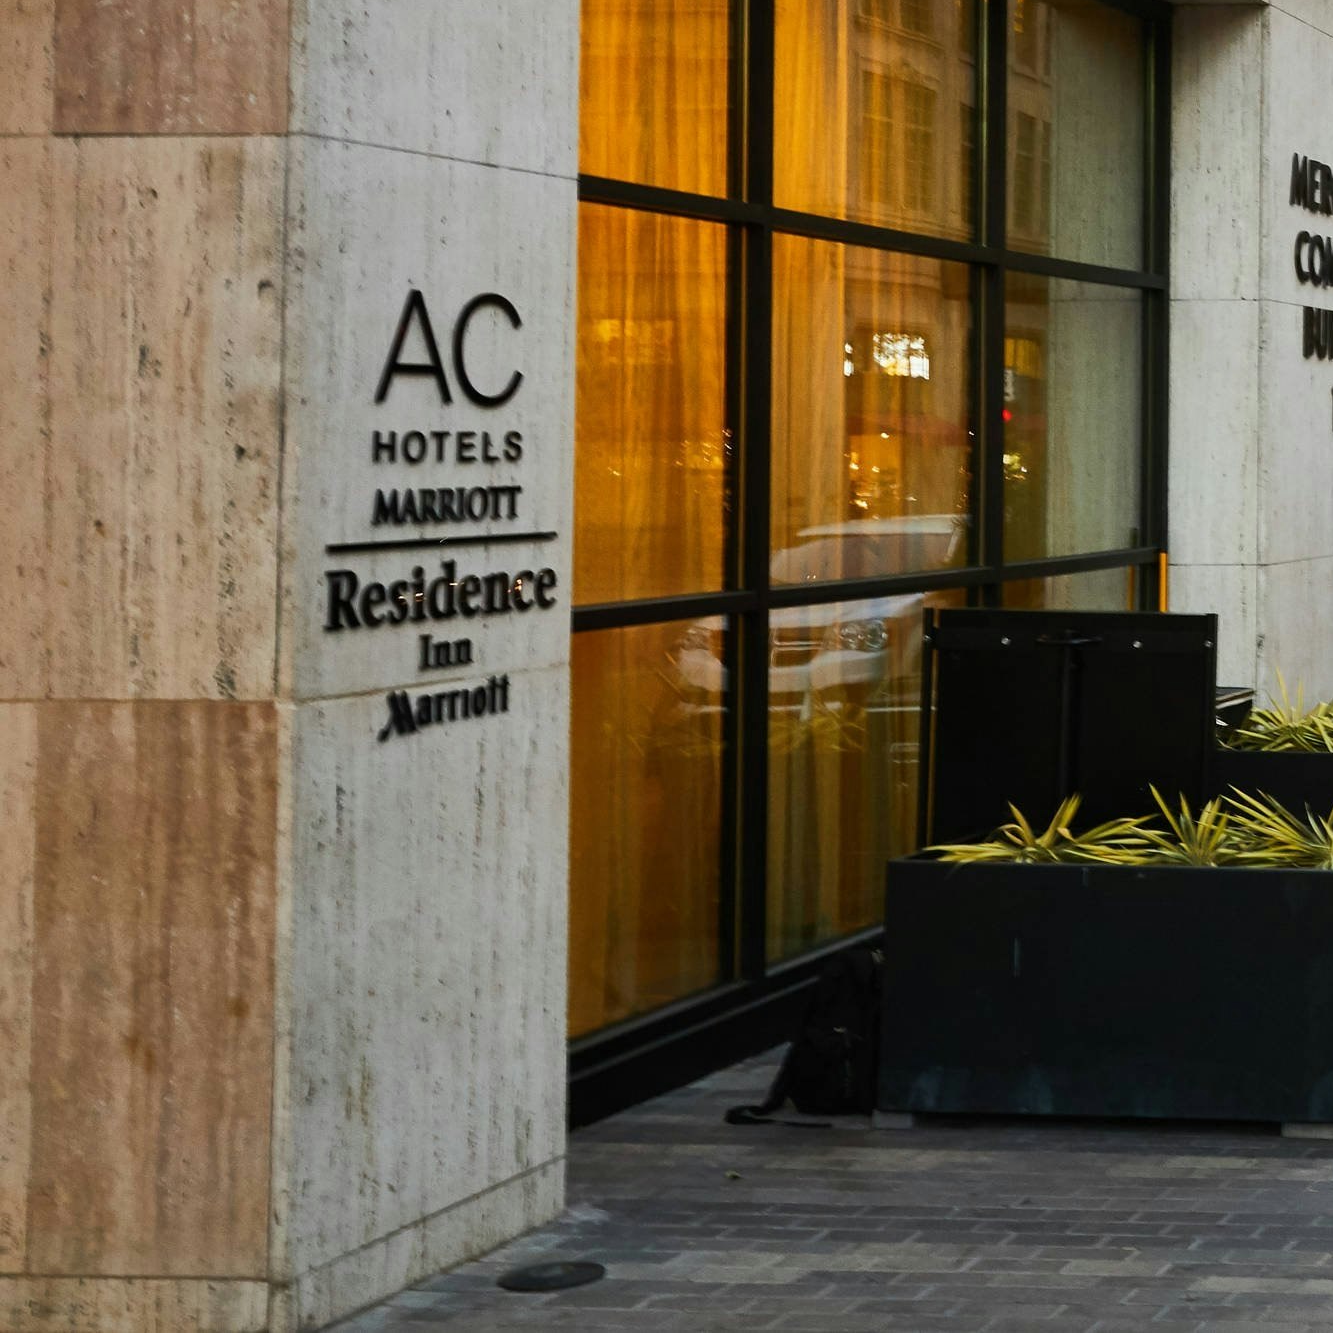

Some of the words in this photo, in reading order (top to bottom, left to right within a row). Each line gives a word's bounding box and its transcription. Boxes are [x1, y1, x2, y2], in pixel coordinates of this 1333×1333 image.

[374, 288, 524, 408] AC
[372, 429, 524, 466] HOTELS
[371, 485, 523, 527] MARRIOTT
[323, 559, 558, 633] Residence
[418, 633, 474, 673] Inn
[376, 674, 511, 743] Marriott
